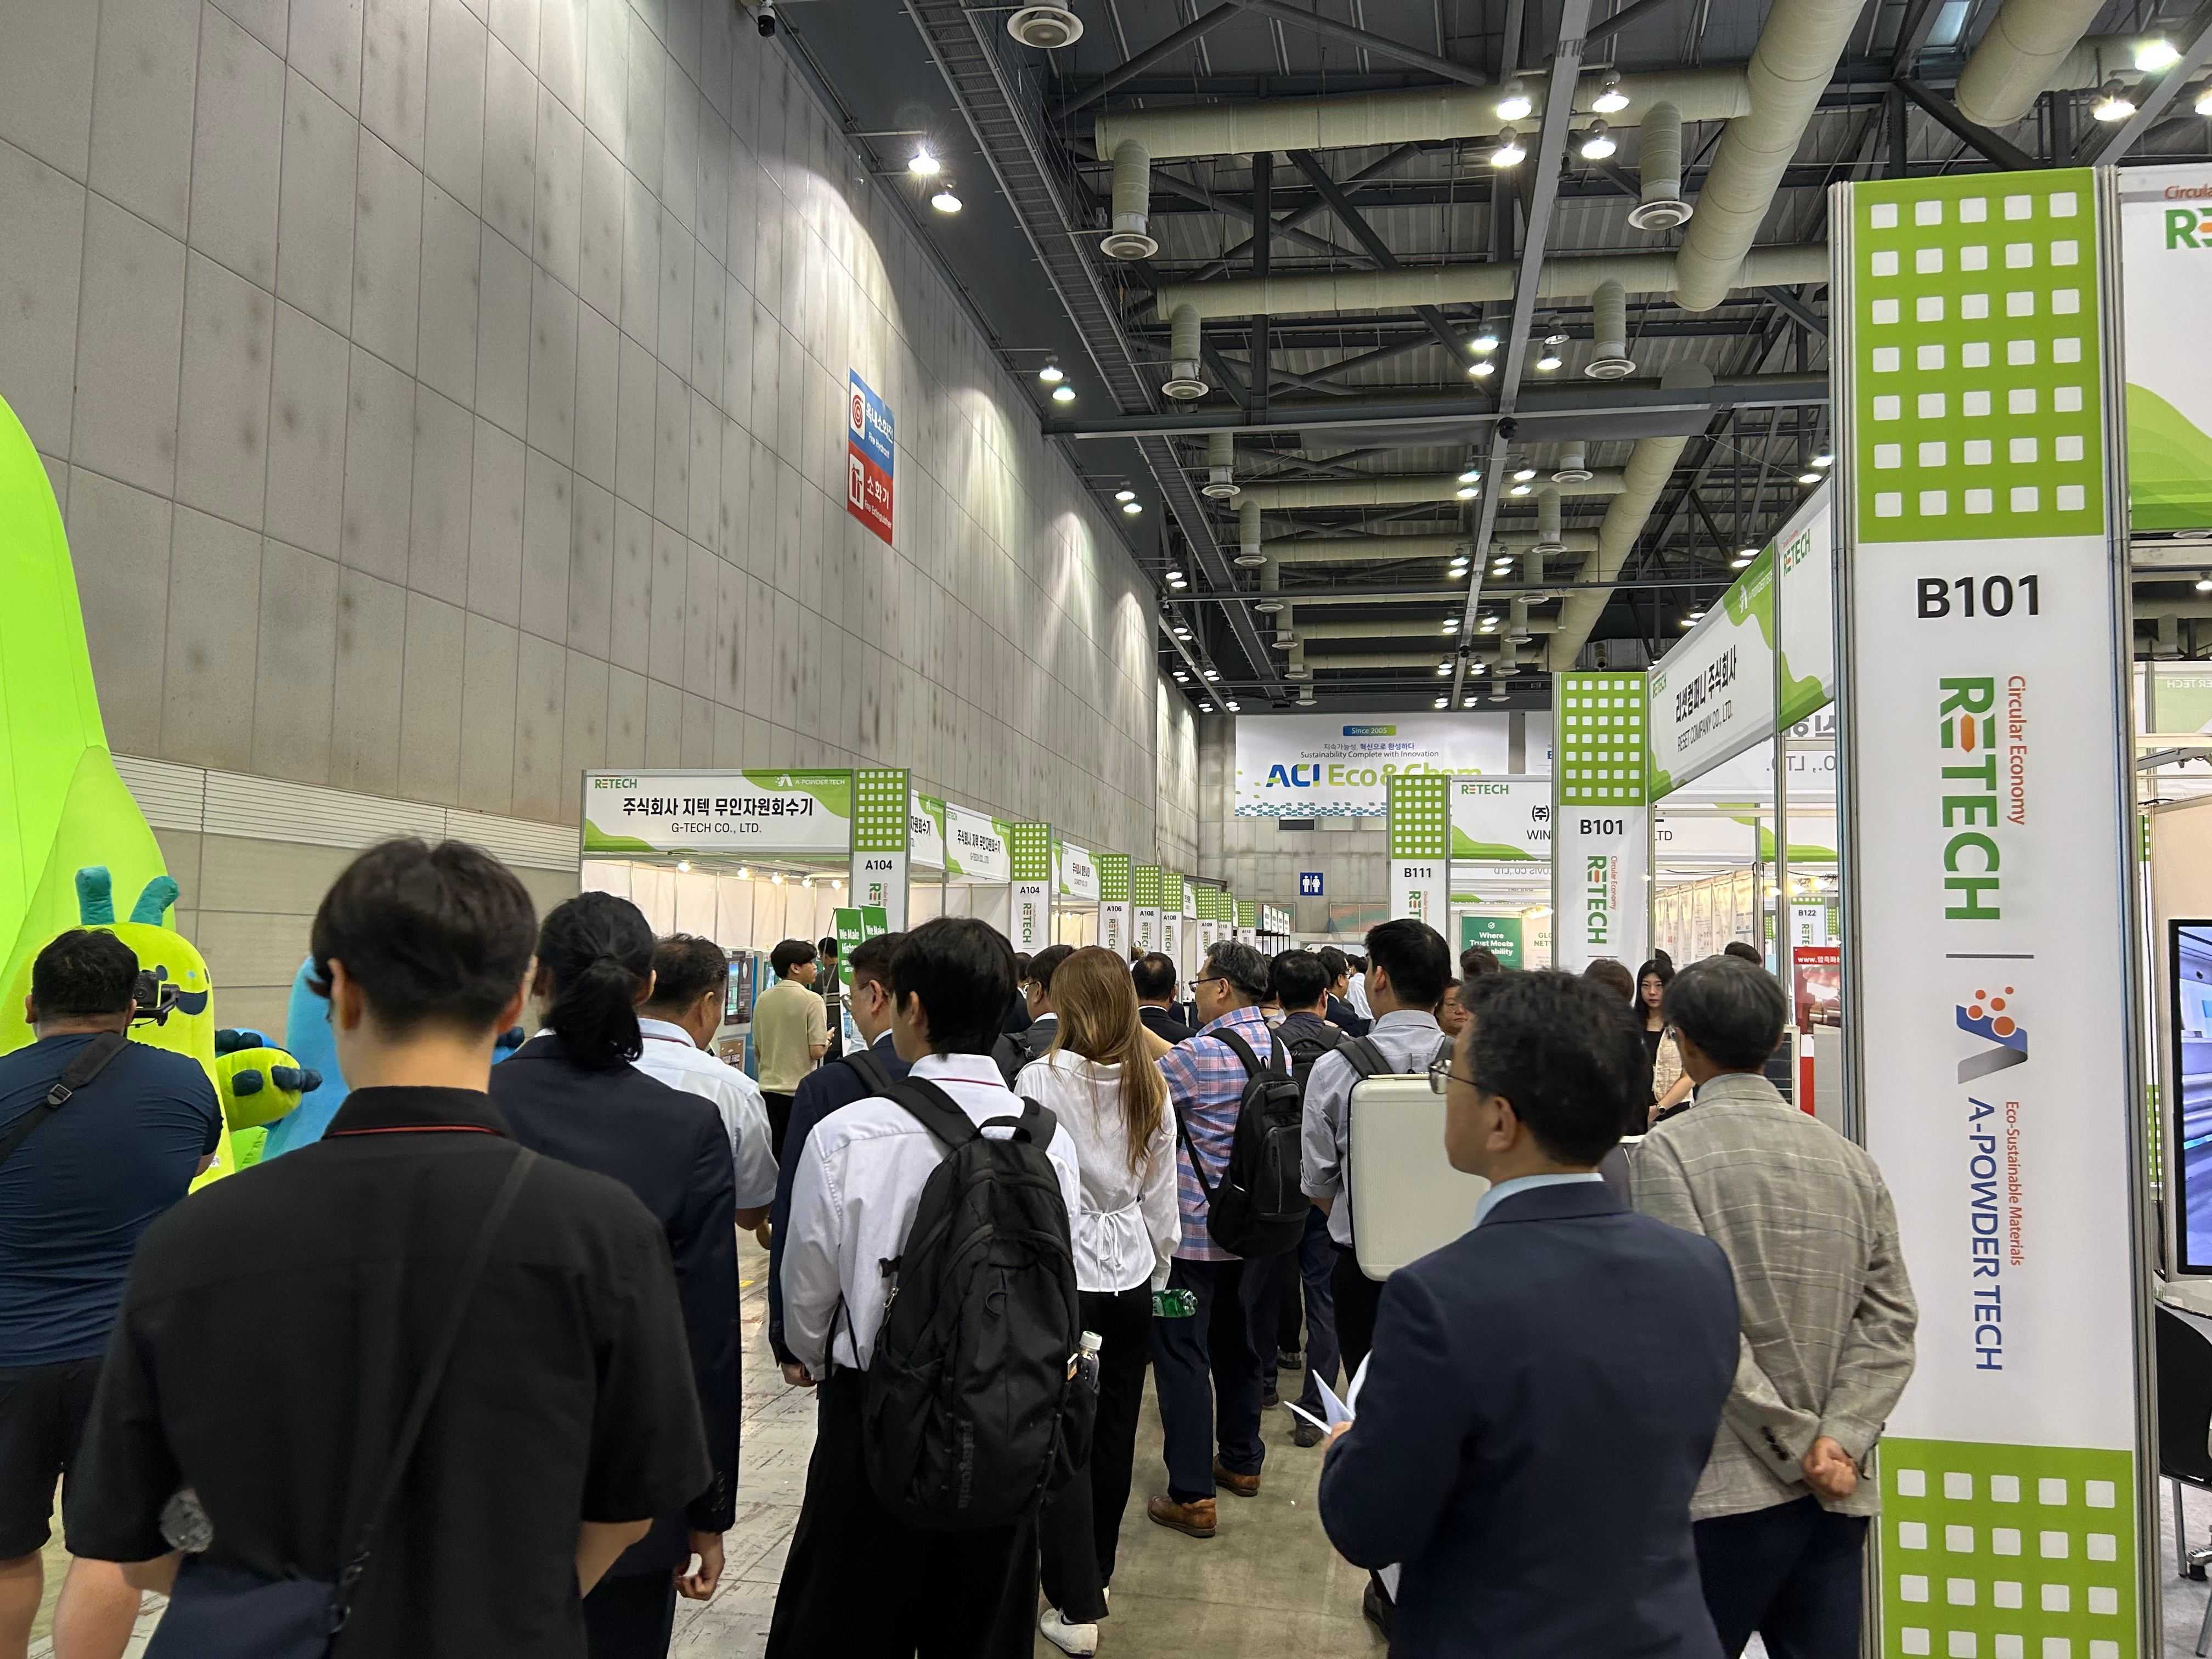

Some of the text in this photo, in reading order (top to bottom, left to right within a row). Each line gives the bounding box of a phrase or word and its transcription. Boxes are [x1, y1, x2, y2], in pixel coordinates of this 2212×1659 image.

[867, 476, 889, 510] 소화기
[1783, 528, 1810, 577] RETECH
[1917, 574, 2039, 618] B101
[1708, 644, 1737, 699] 주식회사
[1301, 751, 1347, 759] Sustainability
[1348, 751, 1382, 759] Complete
[2006, 675, 2028, 826] Circular Economy
[595, 778, 637, 789] RETECH
[1266, 764, 1320, 787] ACI
[1461, 784, 1509, 794] RETECH
[1939, 677, 2001, 920] RETECH
[623, 797, 813, 816] 주식회사 지텍 무인자원회수기
[1532, 805, 1550, 822] (주)
[671, 822, 762, 834] G-TECH CO., LTD.
[1579, 819, 1623, 835] B101
[865, 860, 893, 870] A104
[1404, 867, 1431, 878] B111
[1408, 891, 1421, 921] RET
[1587, 855, 1607, 944] RETECH
[1610, 881, 1618, 910] Economy
[839, 929, 860, 940] We Make
[1023, 902, 1032, 943] RETECH
[1801, 923, 1810, 945] RETE
[2005, 1101, 2025, 1266] Eco-Sustainable Materials
[1968, 1097, 2003, 1371] A-POWDER TECH
